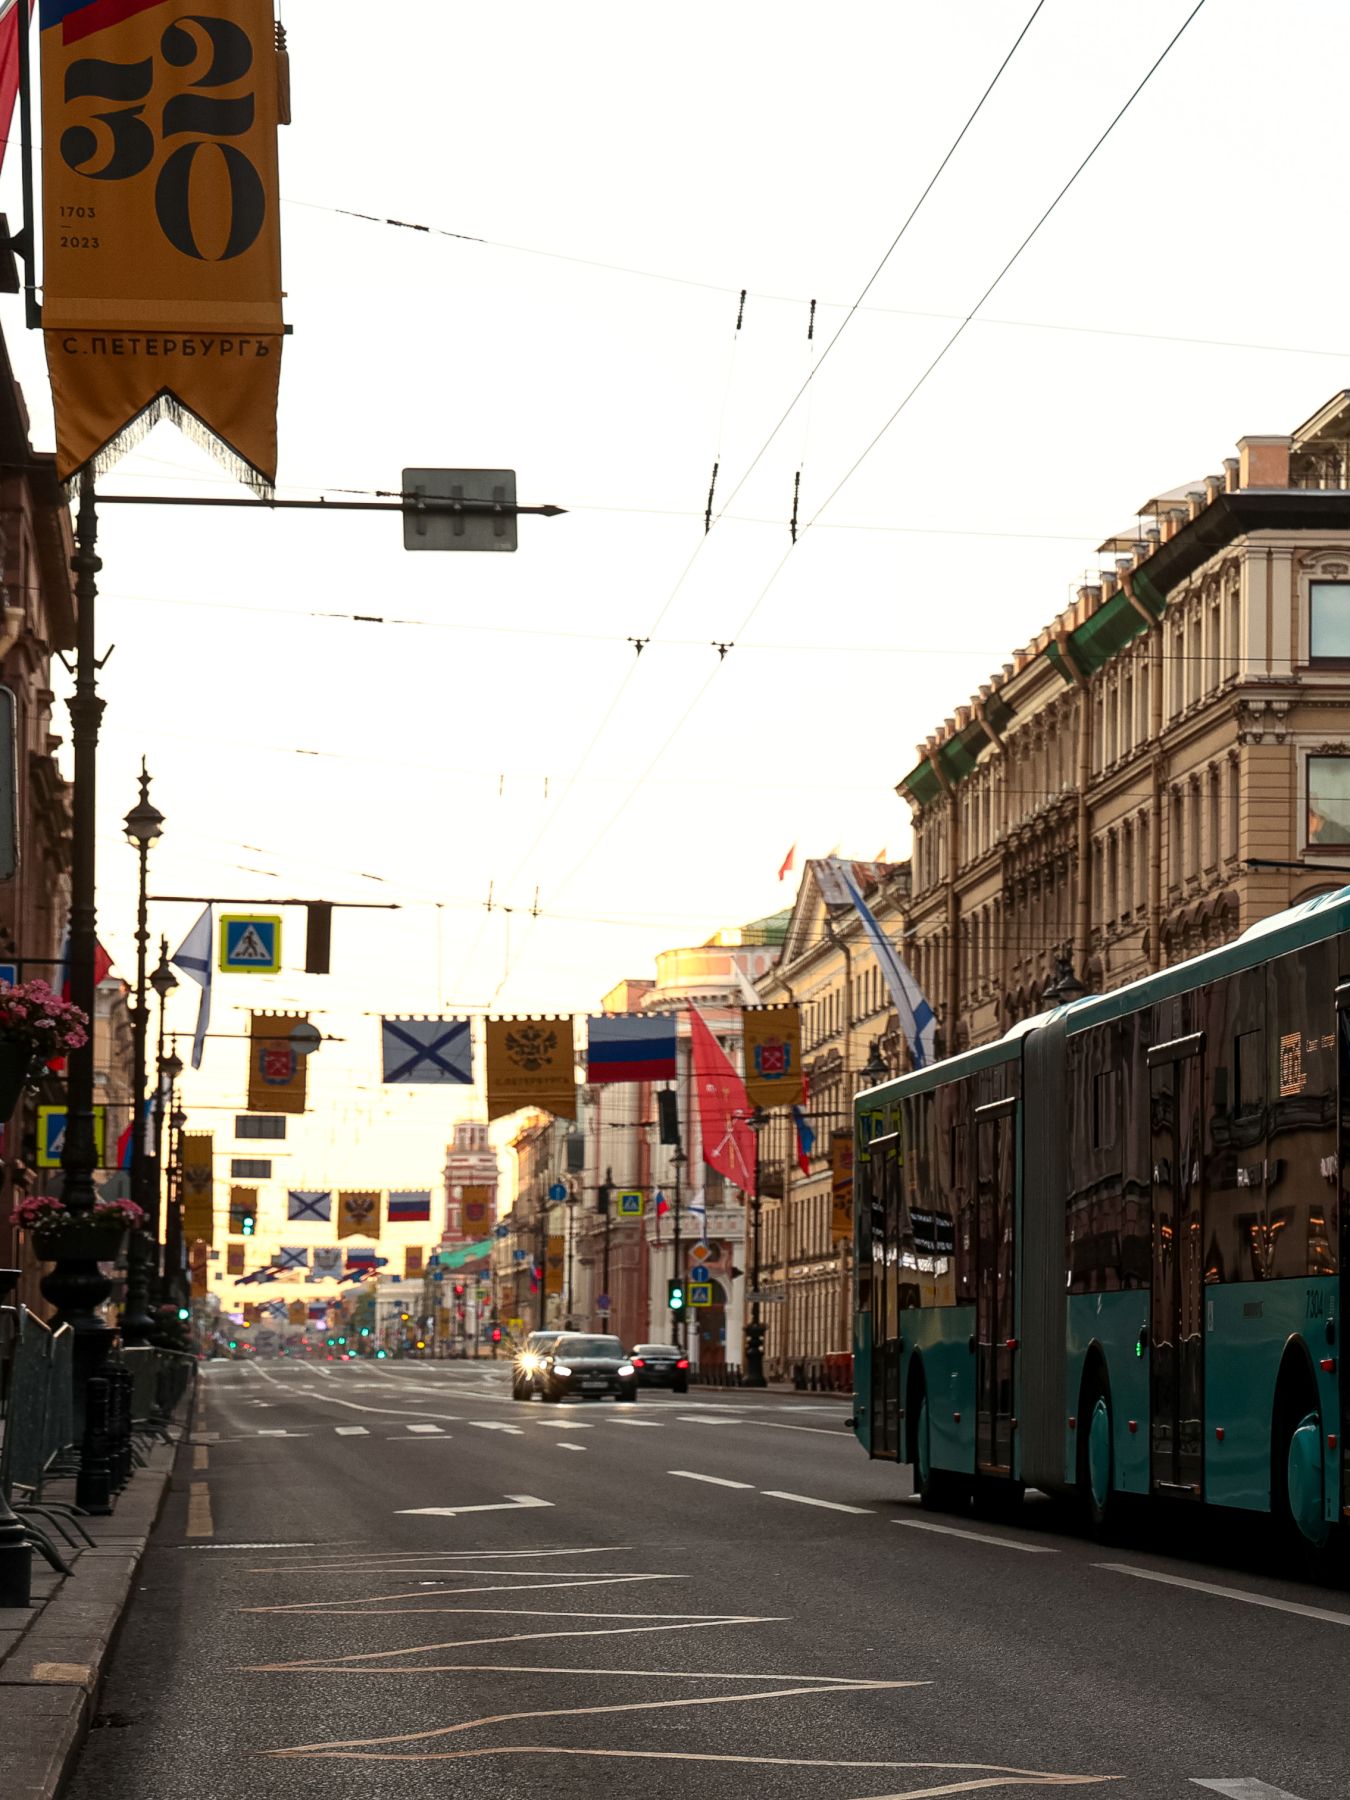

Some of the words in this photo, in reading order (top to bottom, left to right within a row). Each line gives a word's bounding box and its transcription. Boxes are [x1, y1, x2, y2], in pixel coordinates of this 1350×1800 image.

[60, 206, 96, 218] 1703
[60, 236, 100, 248] 2023
[1306, 1289, 1324, 1319] 7304
